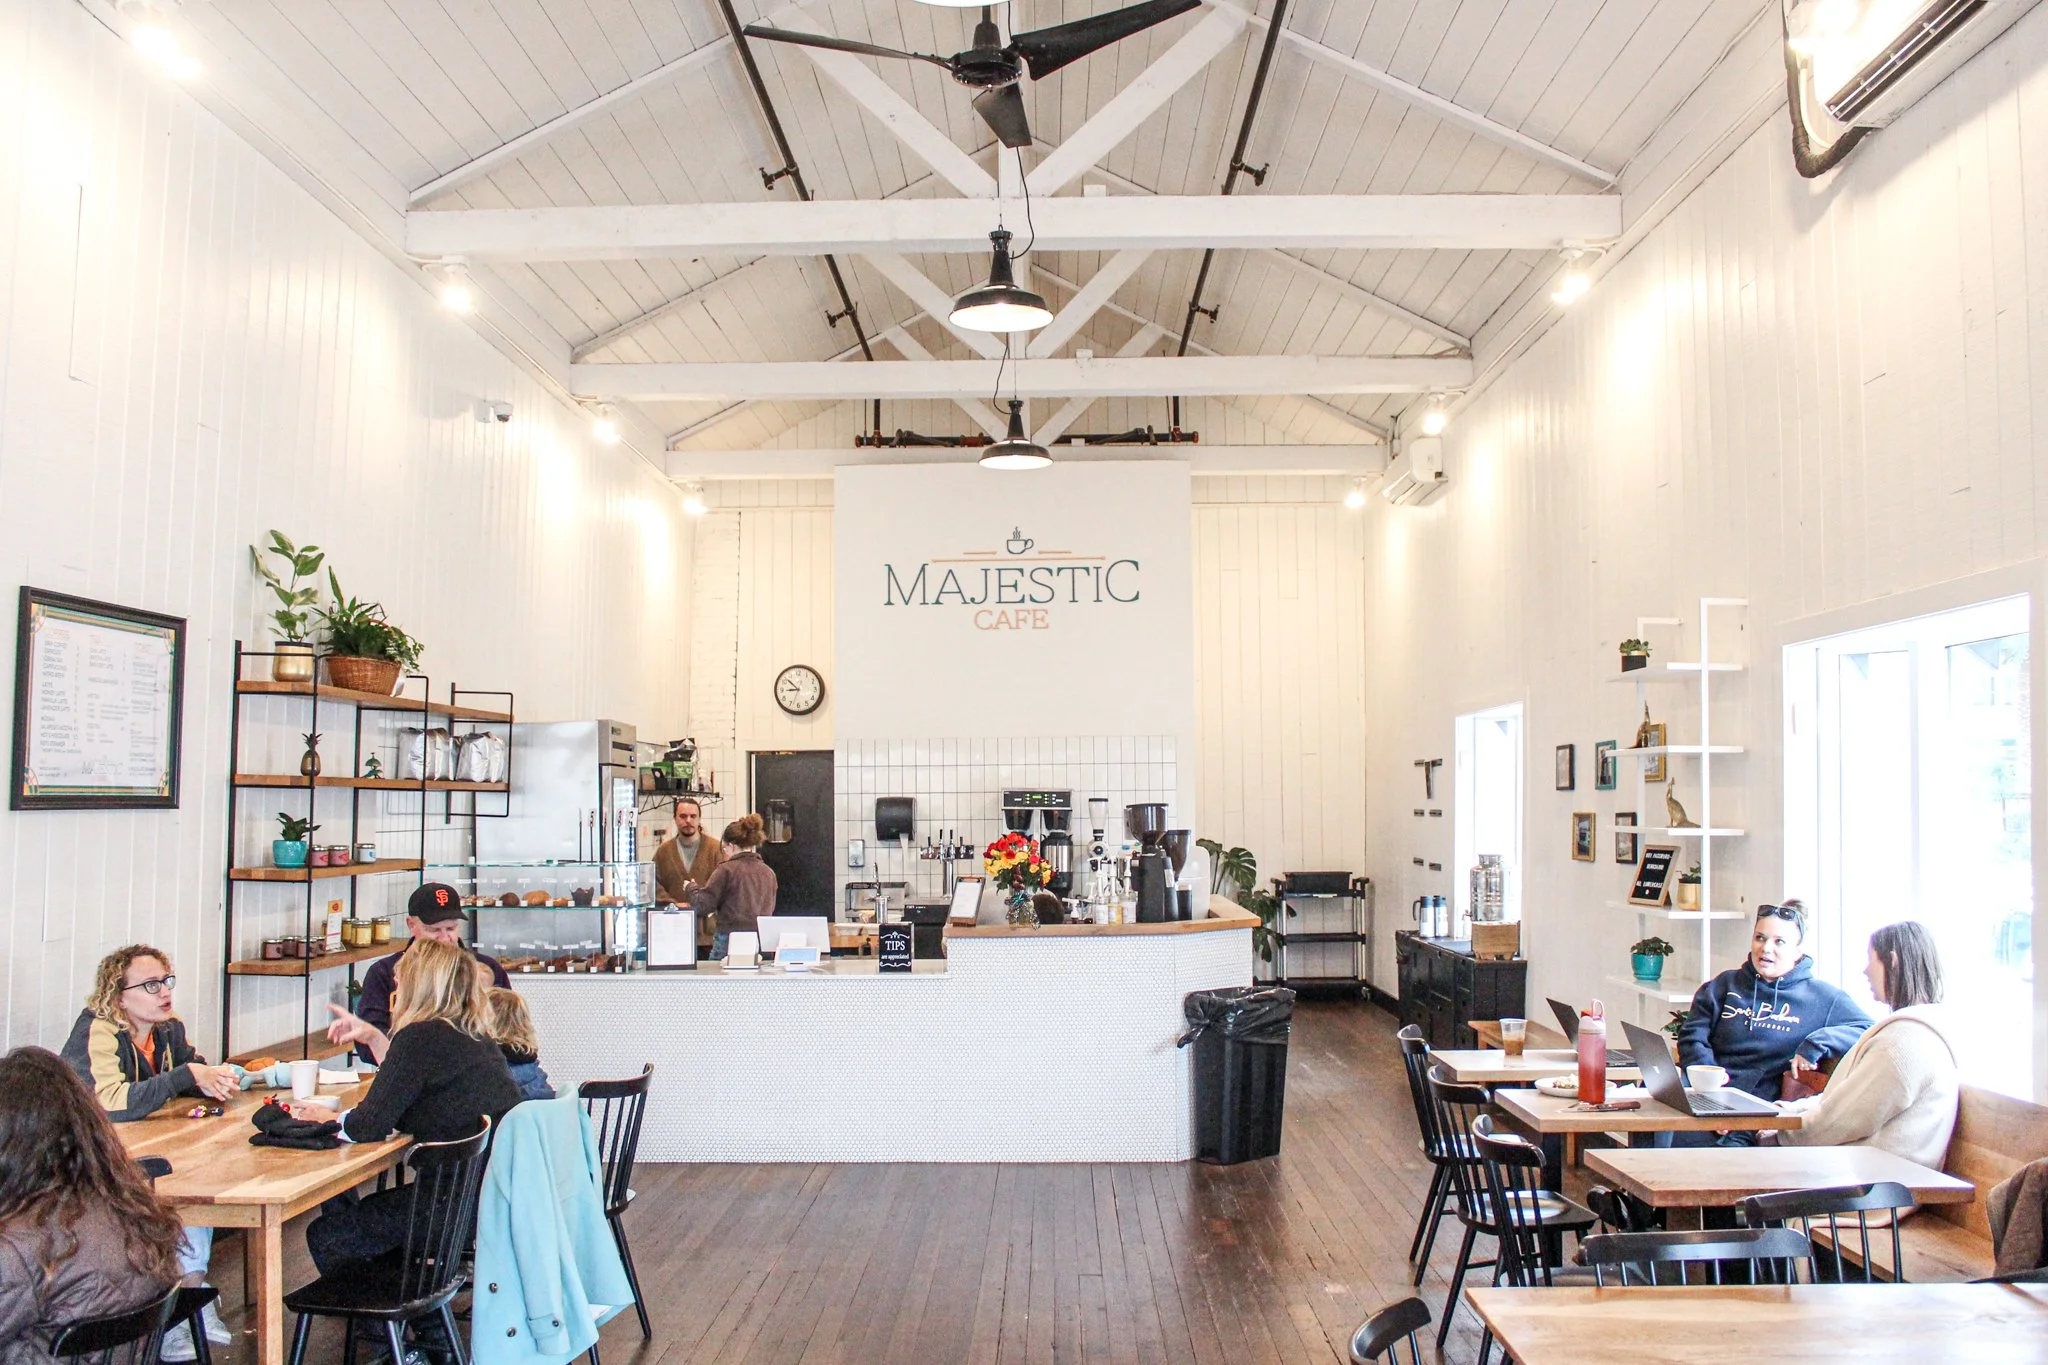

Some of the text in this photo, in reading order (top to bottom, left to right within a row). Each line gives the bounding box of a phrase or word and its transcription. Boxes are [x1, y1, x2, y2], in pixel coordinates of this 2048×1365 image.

[884, 559, 1140, 606] MAJESTIC
[974, 608, 1049, 631] CAFE
[435, 889, 449, 907] SF
[884, 940, 906, 951] TIPS
[888, 953, 910, 961] appreciated
